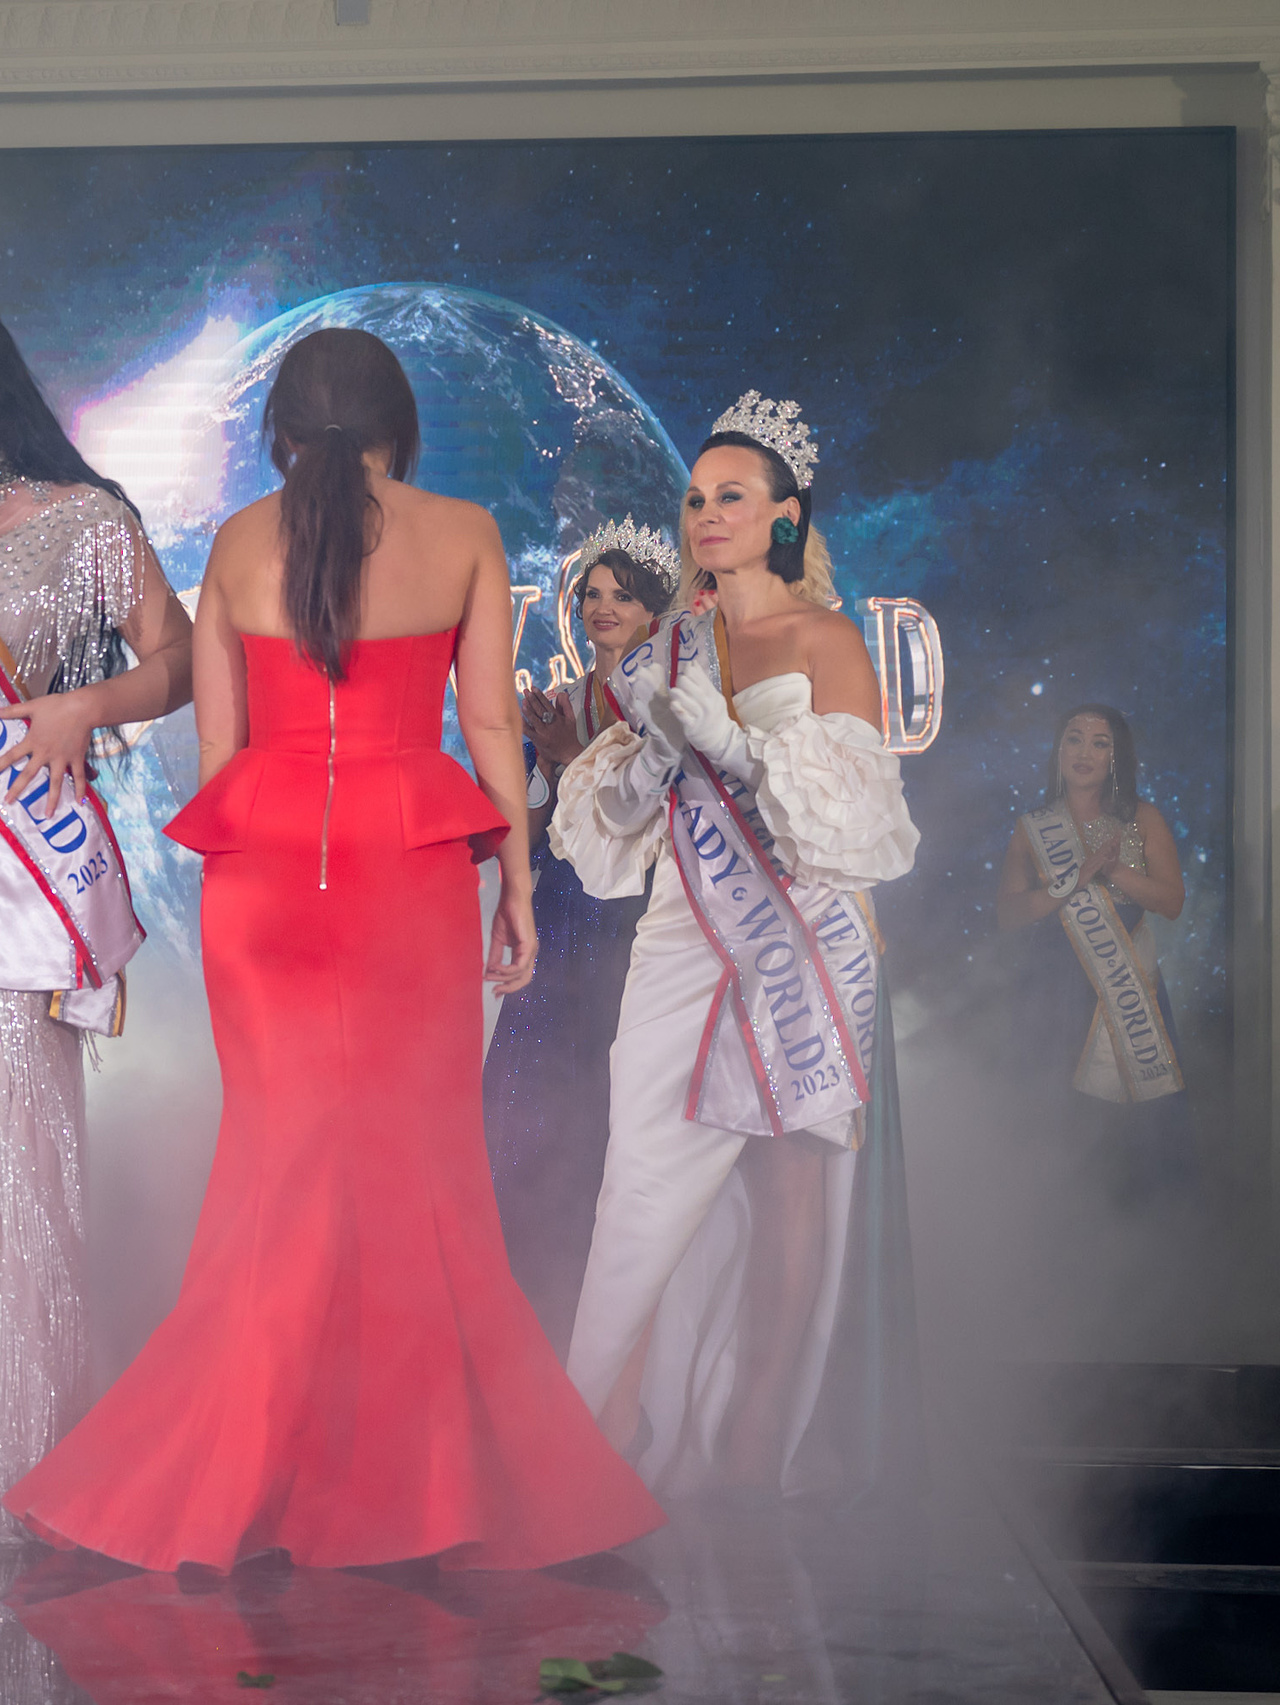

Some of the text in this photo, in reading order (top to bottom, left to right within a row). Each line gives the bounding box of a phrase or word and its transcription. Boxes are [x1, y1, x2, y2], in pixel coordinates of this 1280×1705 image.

[66, 850, 109, 895] 2023
[736, 895, 827, 1072] WORLD
[816, 898, 876, 1072] HE WORL
[1039, 822, 1079, 880] LADY
[1068, 888, 1118, 960] GOLD
[1107, 963, 1159, 1066] WORLD
[790, 1064, 841, 1101] 2023
[1138, 1062, 1168, 1082] 2023
